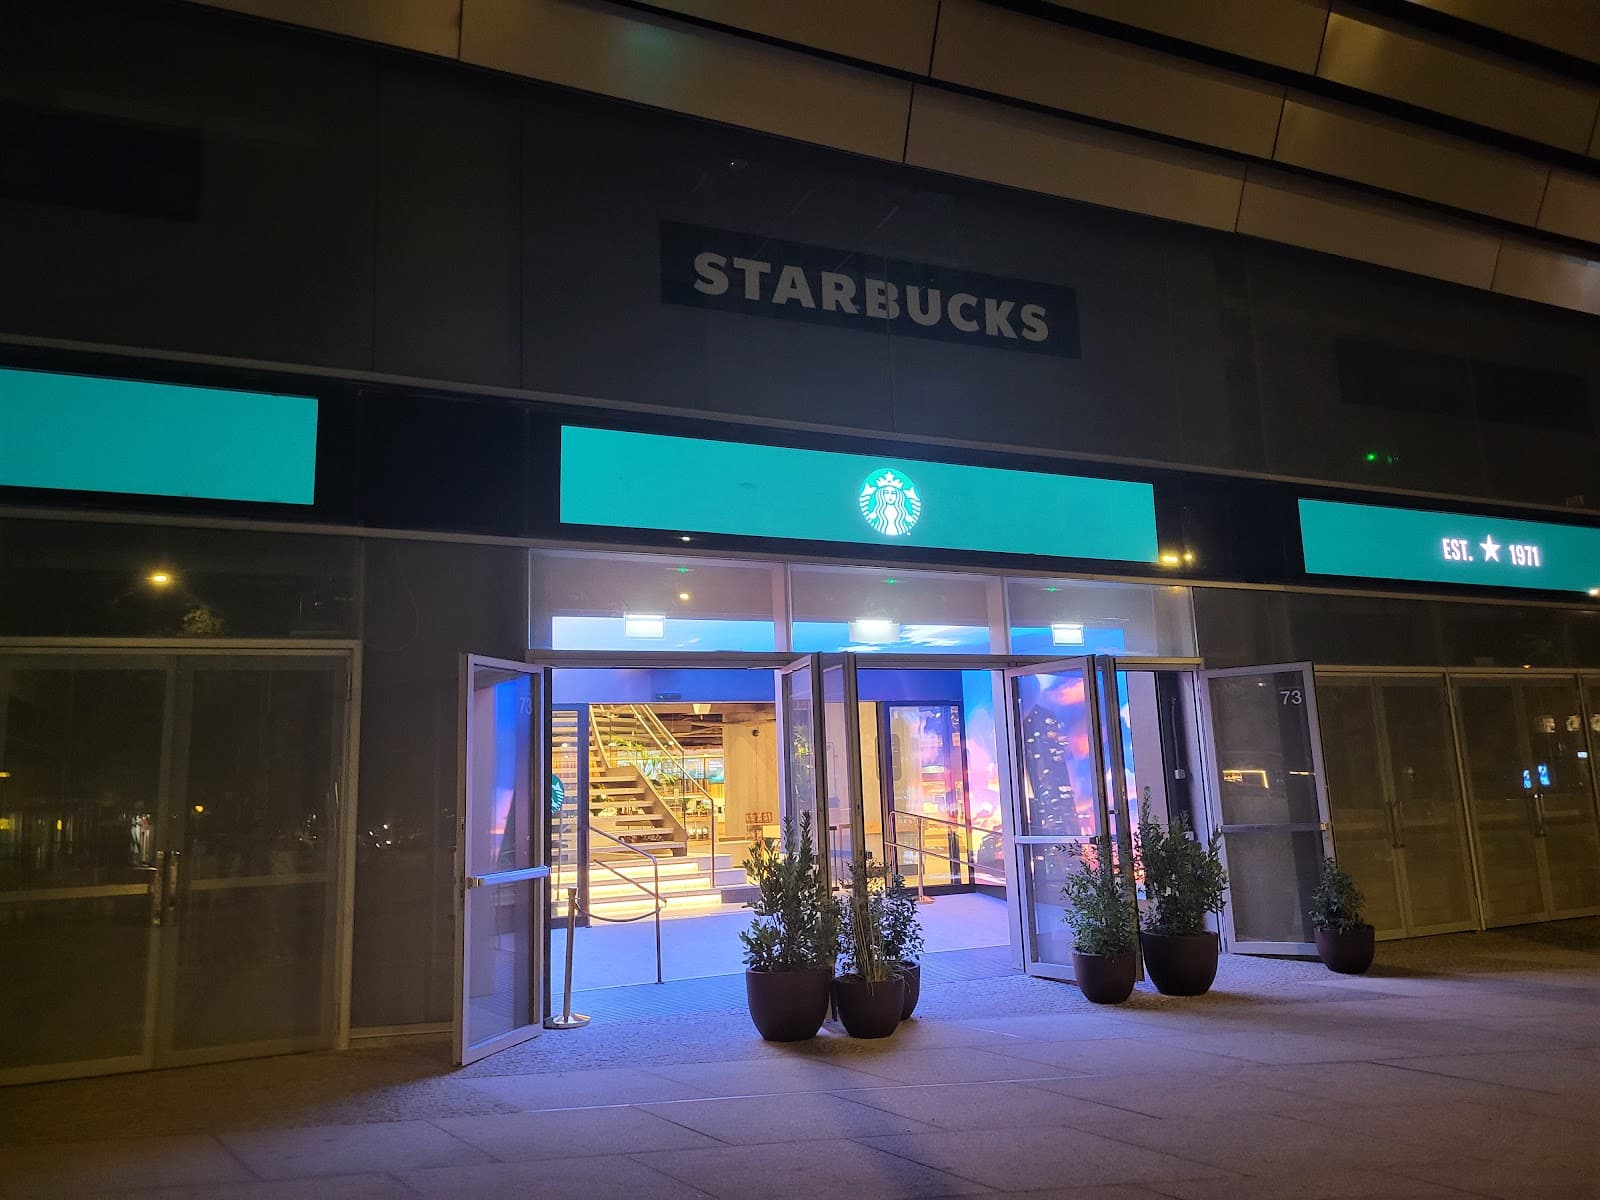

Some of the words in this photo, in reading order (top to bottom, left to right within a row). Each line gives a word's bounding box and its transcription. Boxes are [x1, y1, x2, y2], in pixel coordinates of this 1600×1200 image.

[693, 252, 1049, 342] STARBUCKS
[1442, 538, 1474, 561] EST.
[1508, 544, 1540, 567] 1971
[1280, 690, 1302, 705] 73
